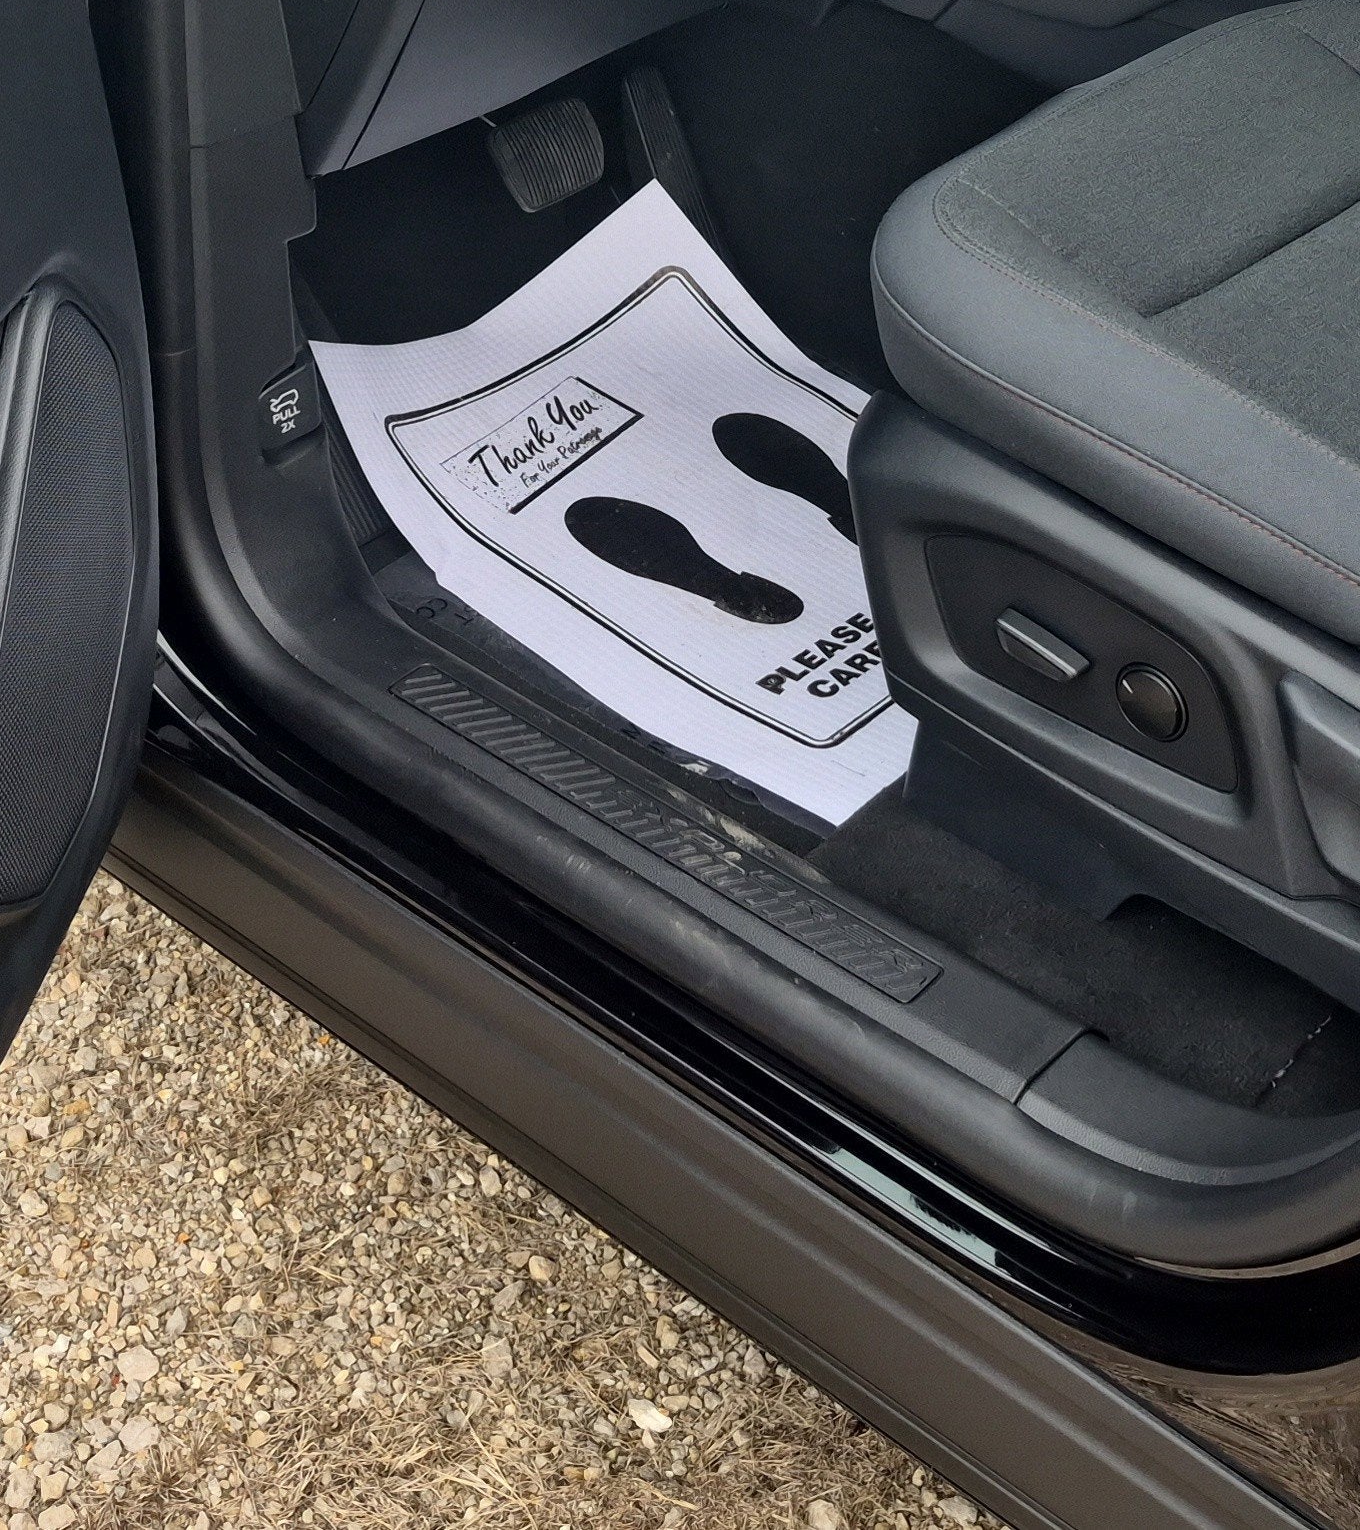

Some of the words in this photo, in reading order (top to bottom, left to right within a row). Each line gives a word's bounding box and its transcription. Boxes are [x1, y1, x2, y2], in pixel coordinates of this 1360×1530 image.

[272, 405, 302, 425] PULL
[280, 420, 297, 434] 2X
[468, 416, 555, 487] Thank
[519, 468, 540, 489] For
[538, 454, 561, 475] Your
[755, 612, 875, 695] PLEASE
